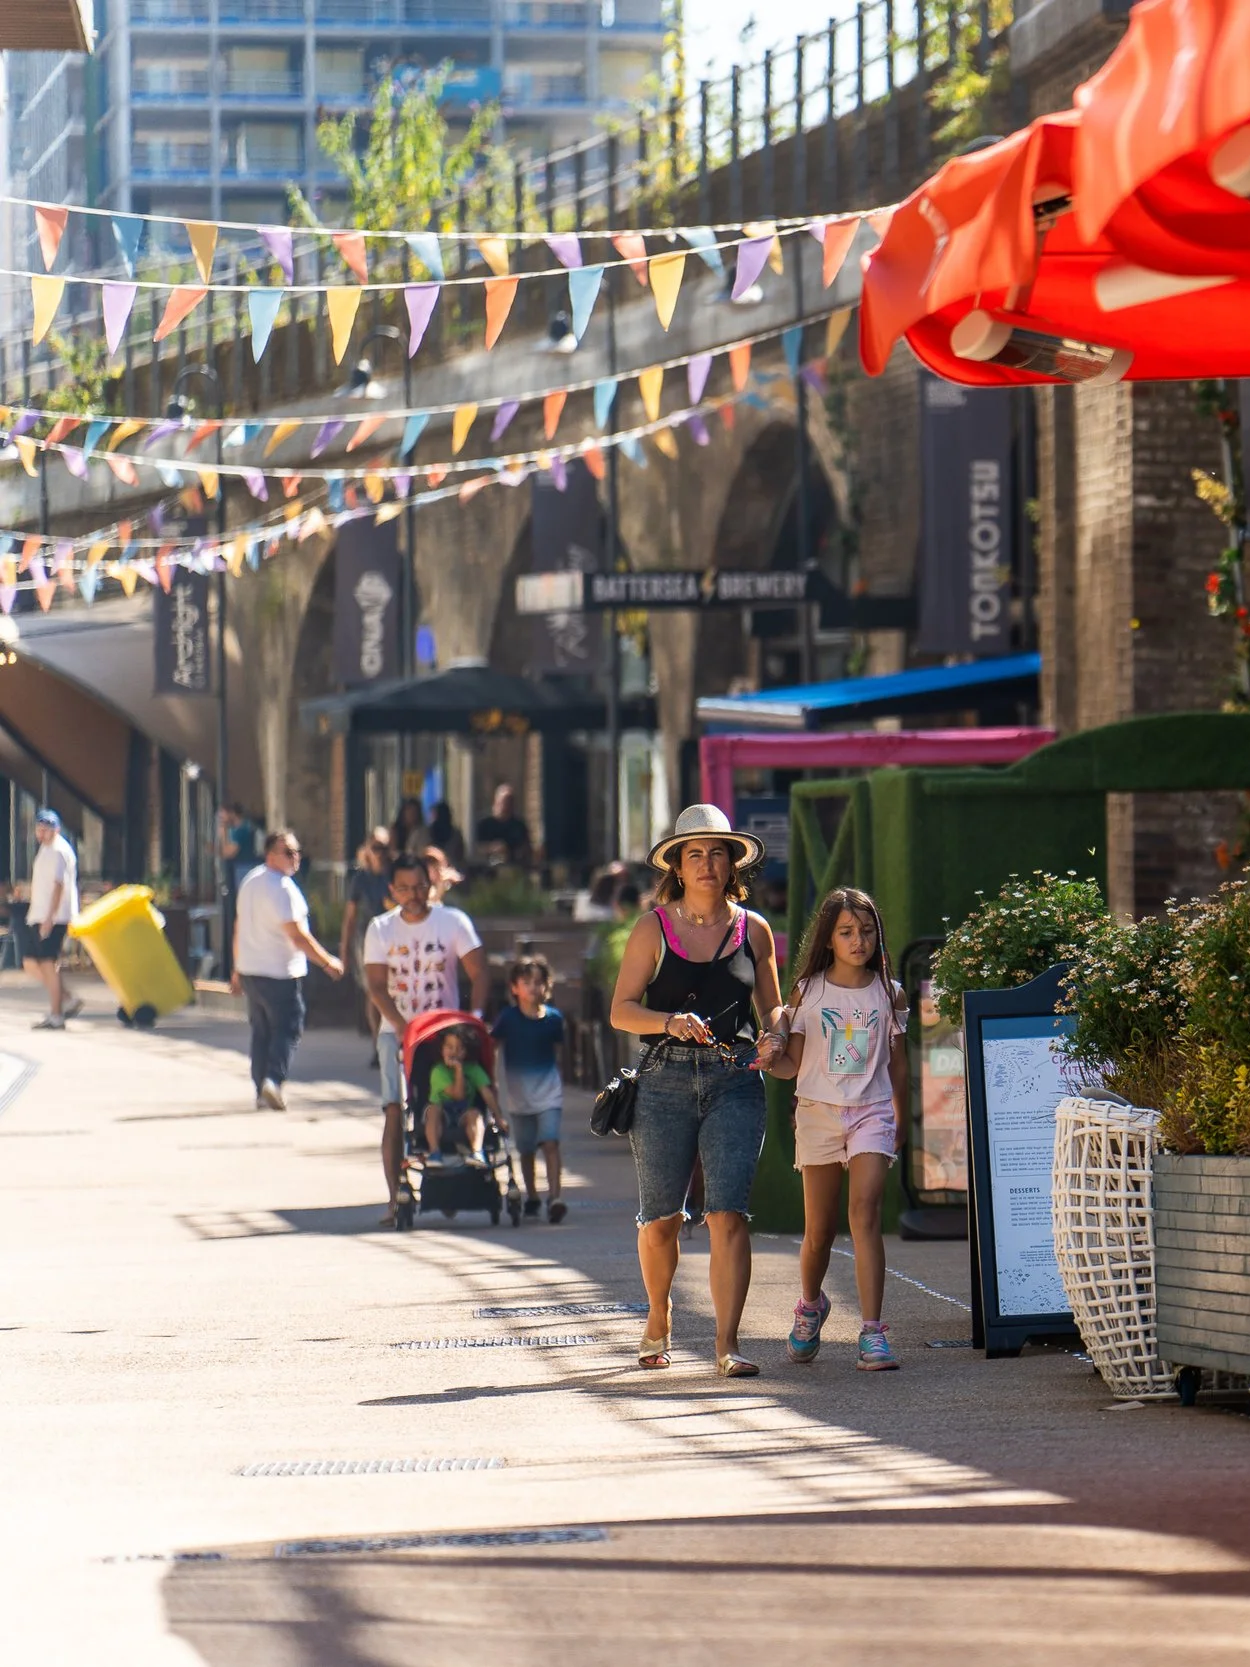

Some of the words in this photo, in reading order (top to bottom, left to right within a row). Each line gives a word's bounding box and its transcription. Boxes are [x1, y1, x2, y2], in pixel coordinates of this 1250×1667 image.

[592, 573, 698, 602] BATTERSEA
[718, 571, 808, 600] BREWERY
[936, 1054, 962, 1071] DA
